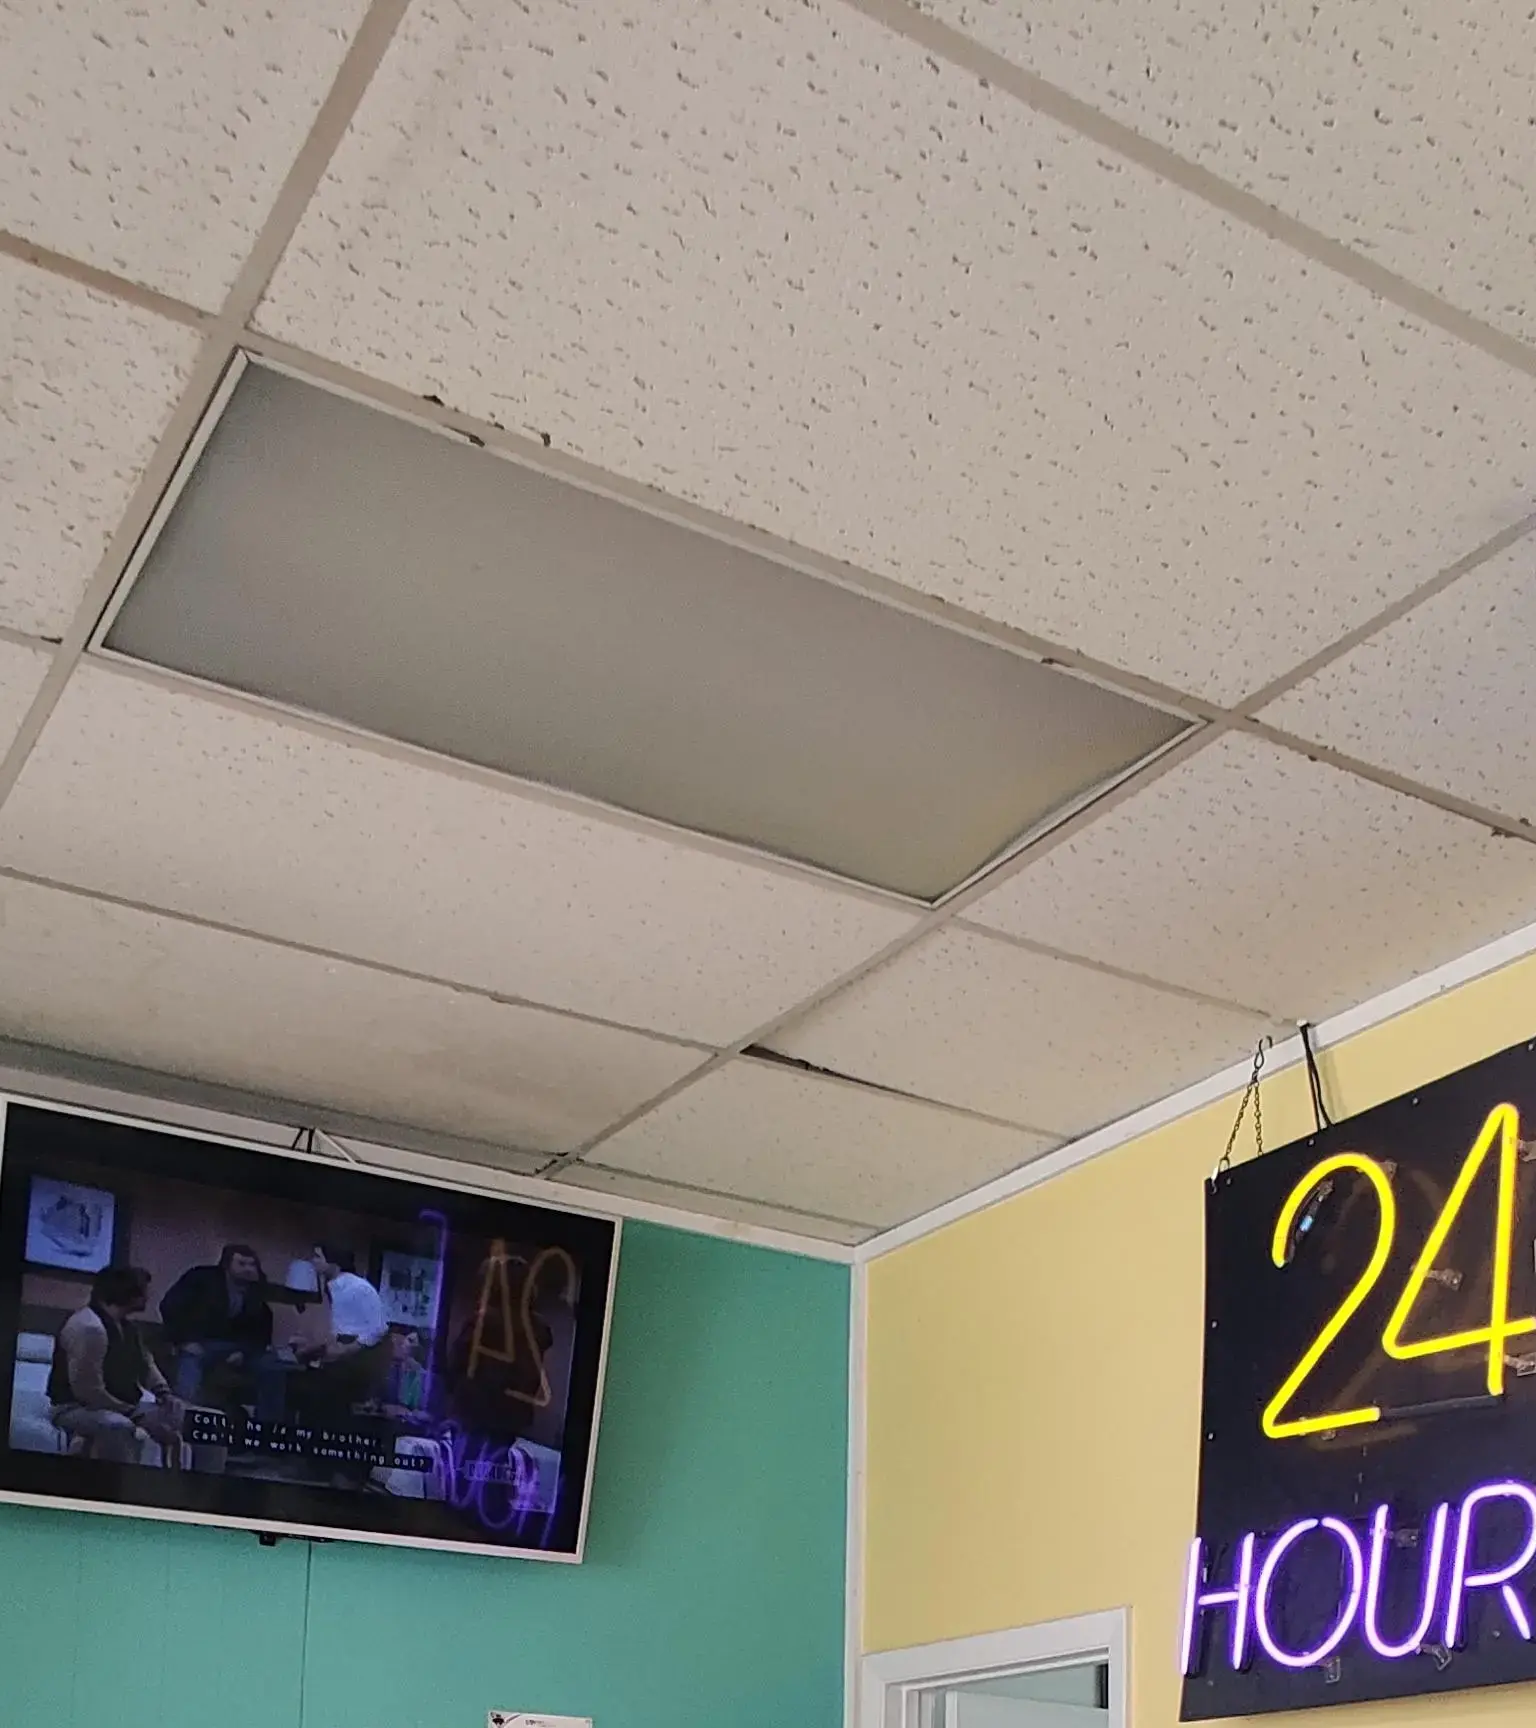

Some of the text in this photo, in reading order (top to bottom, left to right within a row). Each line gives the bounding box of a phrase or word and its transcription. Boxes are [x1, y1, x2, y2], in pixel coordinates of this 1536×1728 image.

[192, 1429, 426, 1468] Can't we work something out?
[246, 1420, 263, 1432] he
[272, 1422, 287, 1435] is
[296, 1428, 312, 1440] my
[323, 1429, 385, 1448] brother.
